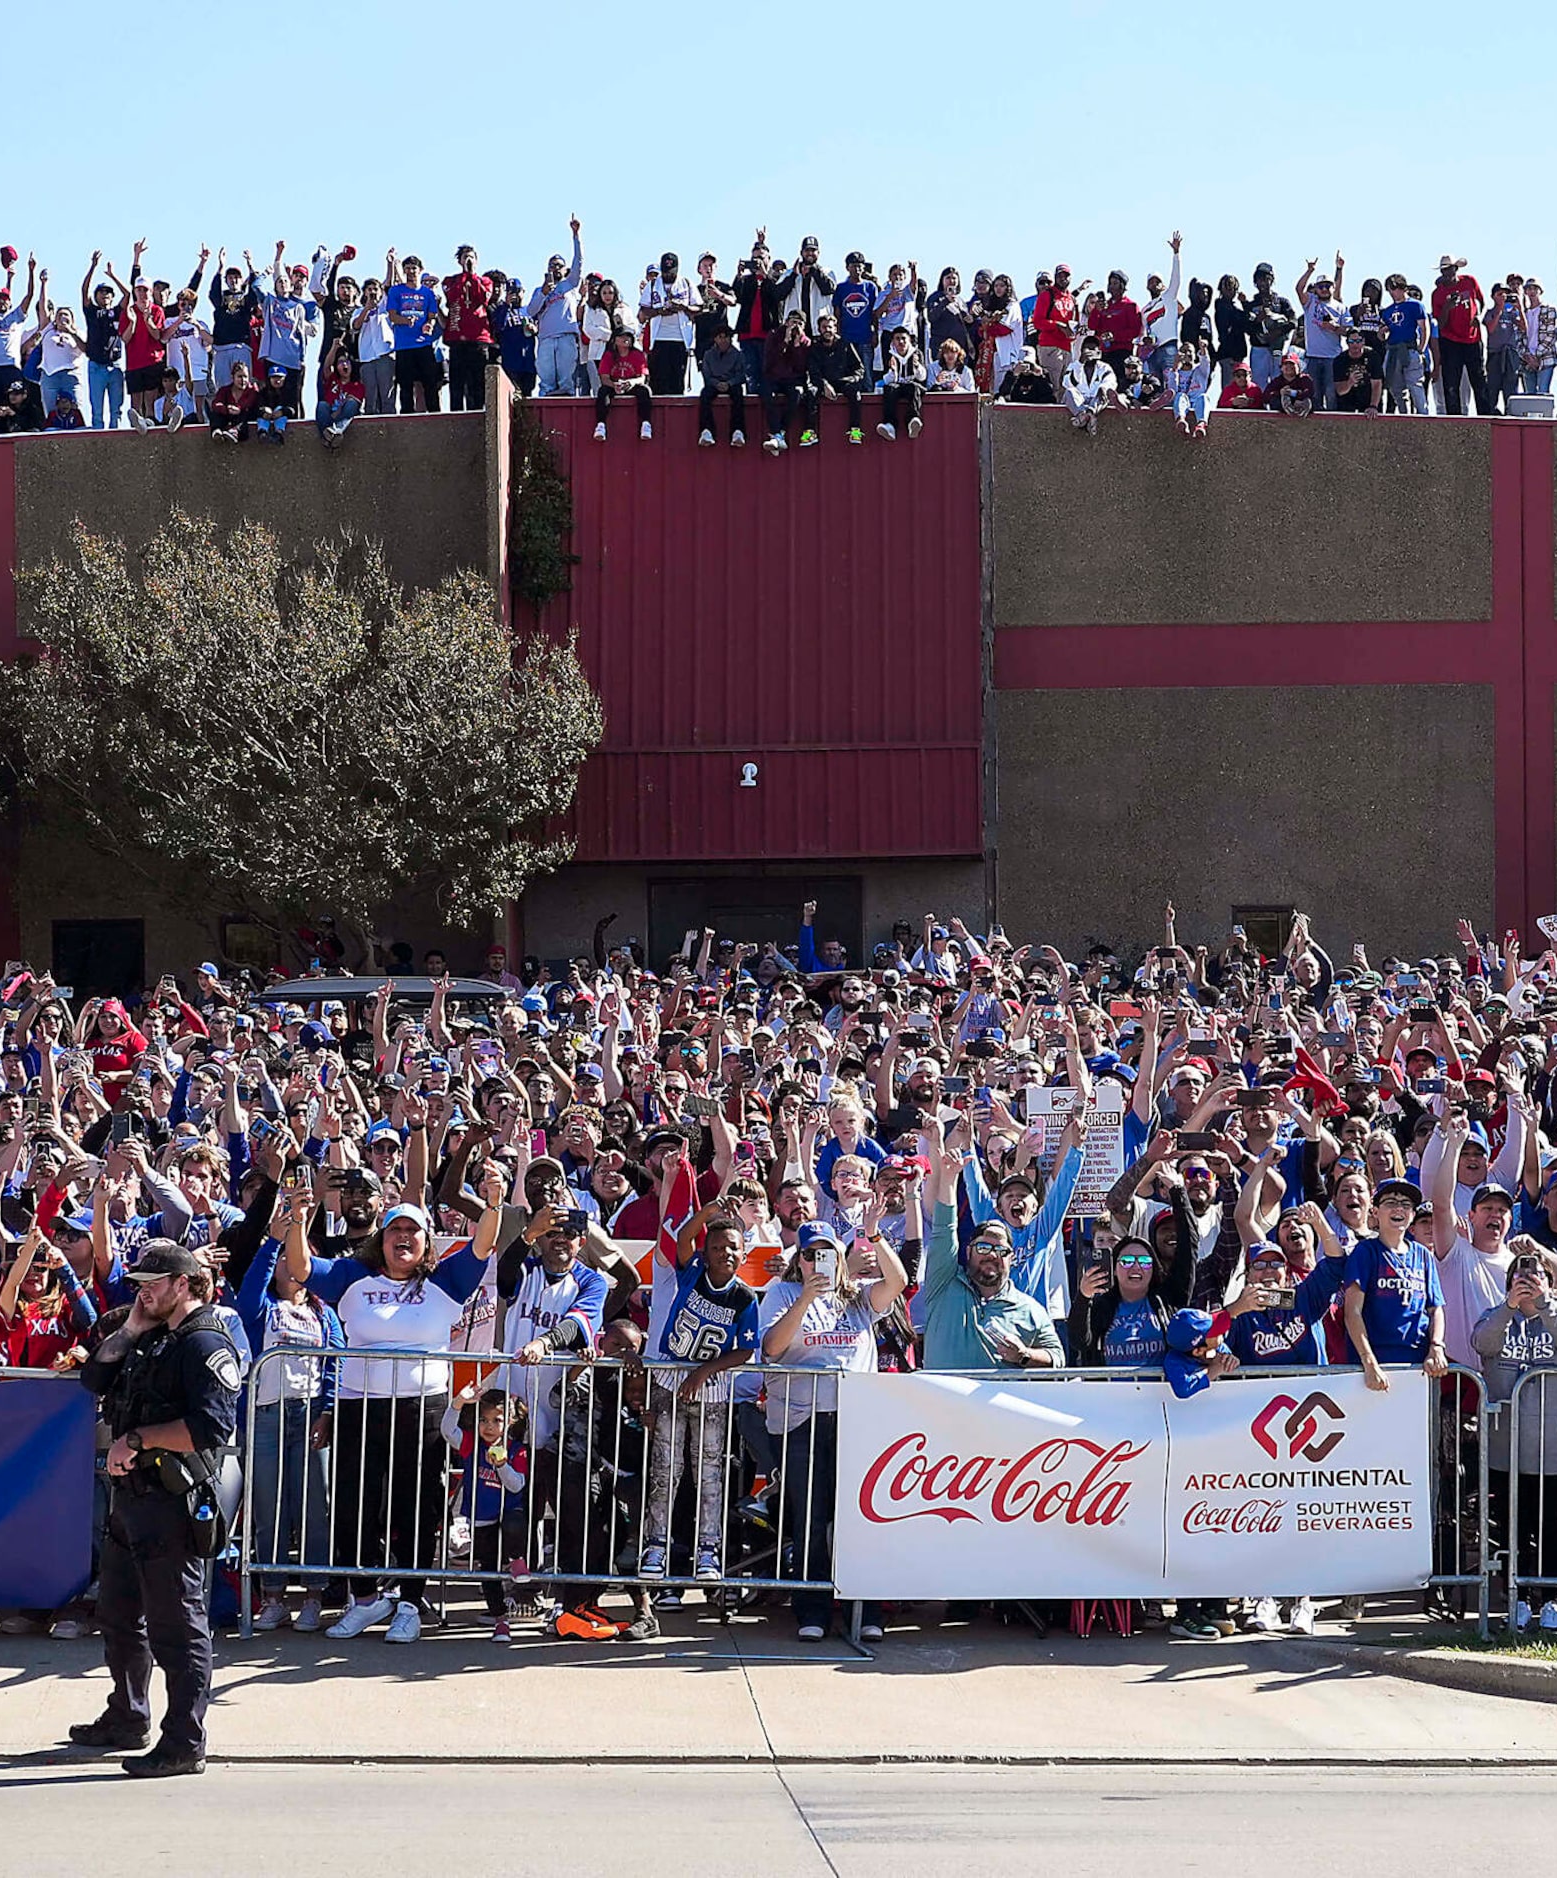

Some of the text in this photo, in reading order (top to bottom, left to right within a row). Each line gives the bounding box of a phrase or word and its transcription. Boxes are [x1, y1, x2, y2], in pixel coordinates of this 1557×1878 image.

[312, 1033, 324, 1043] T
[361, 1290, 427, 1306] TEXAS
[687, 1289, 736, 1326] PARISH
[30, 1317, 68, 1341] XAS
[668, 1308, 728, 1361] 56
[1105, 1340, 1164, 1356] HAMPION
[859, 1432, 1152, 1527] Coca-Cola
[1184, 1469, 1412, 1491] ARCACONTINENTAL
[1183, 1498, 1289, 1534] Coca-Cola
[1295, 1500, 1413, 1516] SOUTHWEST
[1296, 1516, 1413, 1531] BEVERAGES
